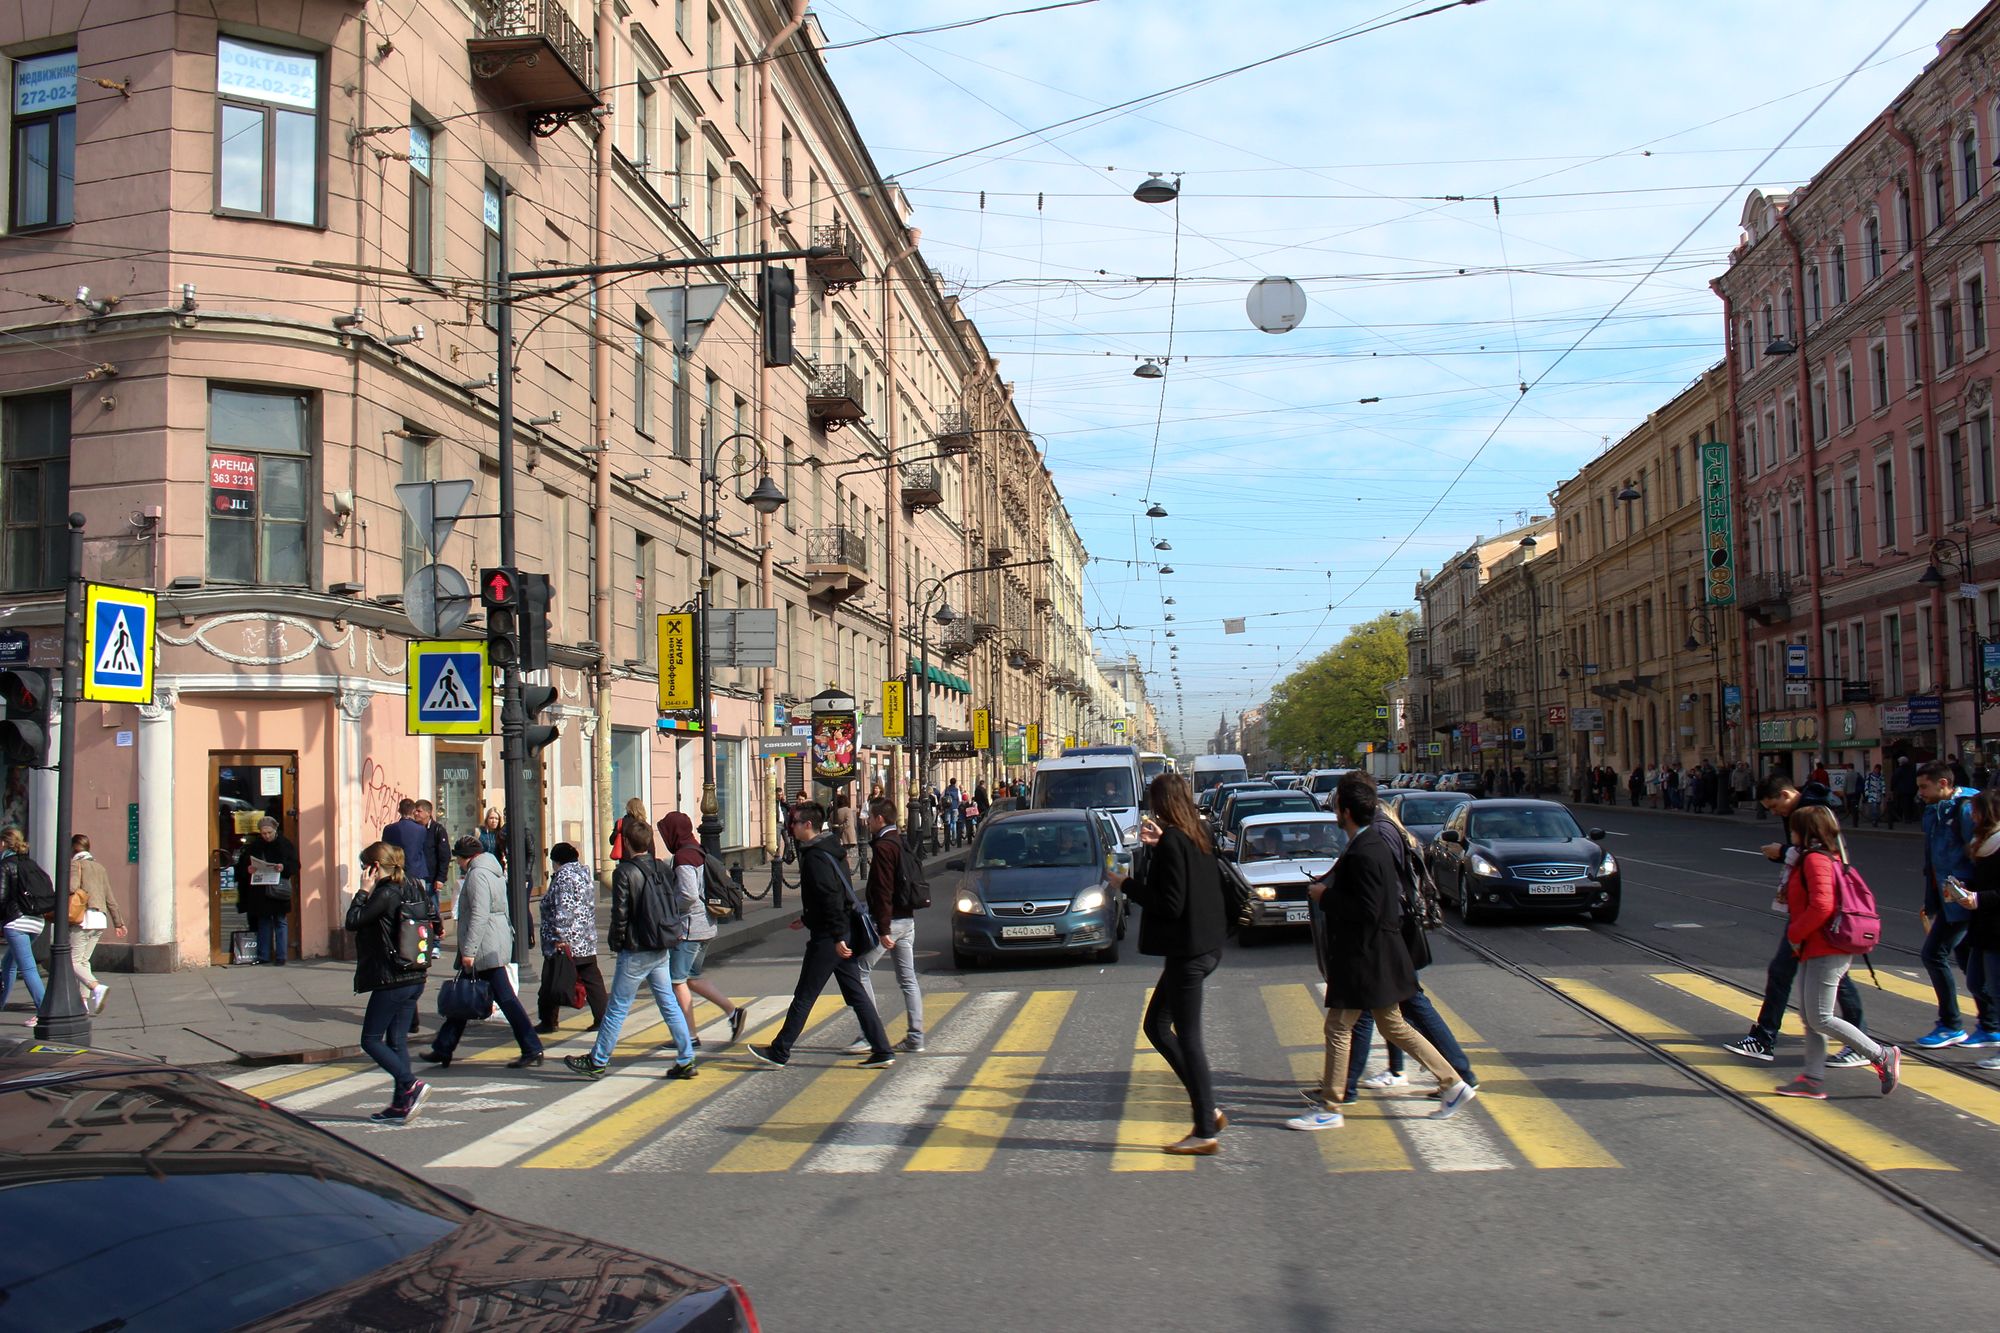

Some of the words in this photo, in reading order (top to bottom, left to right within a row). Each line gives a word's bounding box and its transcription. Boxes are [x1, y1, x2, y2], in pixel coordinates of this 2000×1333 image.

[221, 71, 311, 99] 272-02-22
[211, 459, 255, 474] АРЕНДА
[213, 473, 230, 484] 363
[232, 475, 253, 486] 3231
[676, 638, 684, 665] БАНК
[668, 637, 676, 697] Райффайзен
[1550, 708, 1566, 719] 24
[1844, 717, 1852, 734] 24
[443, 768, 469, 780] INCANTO
